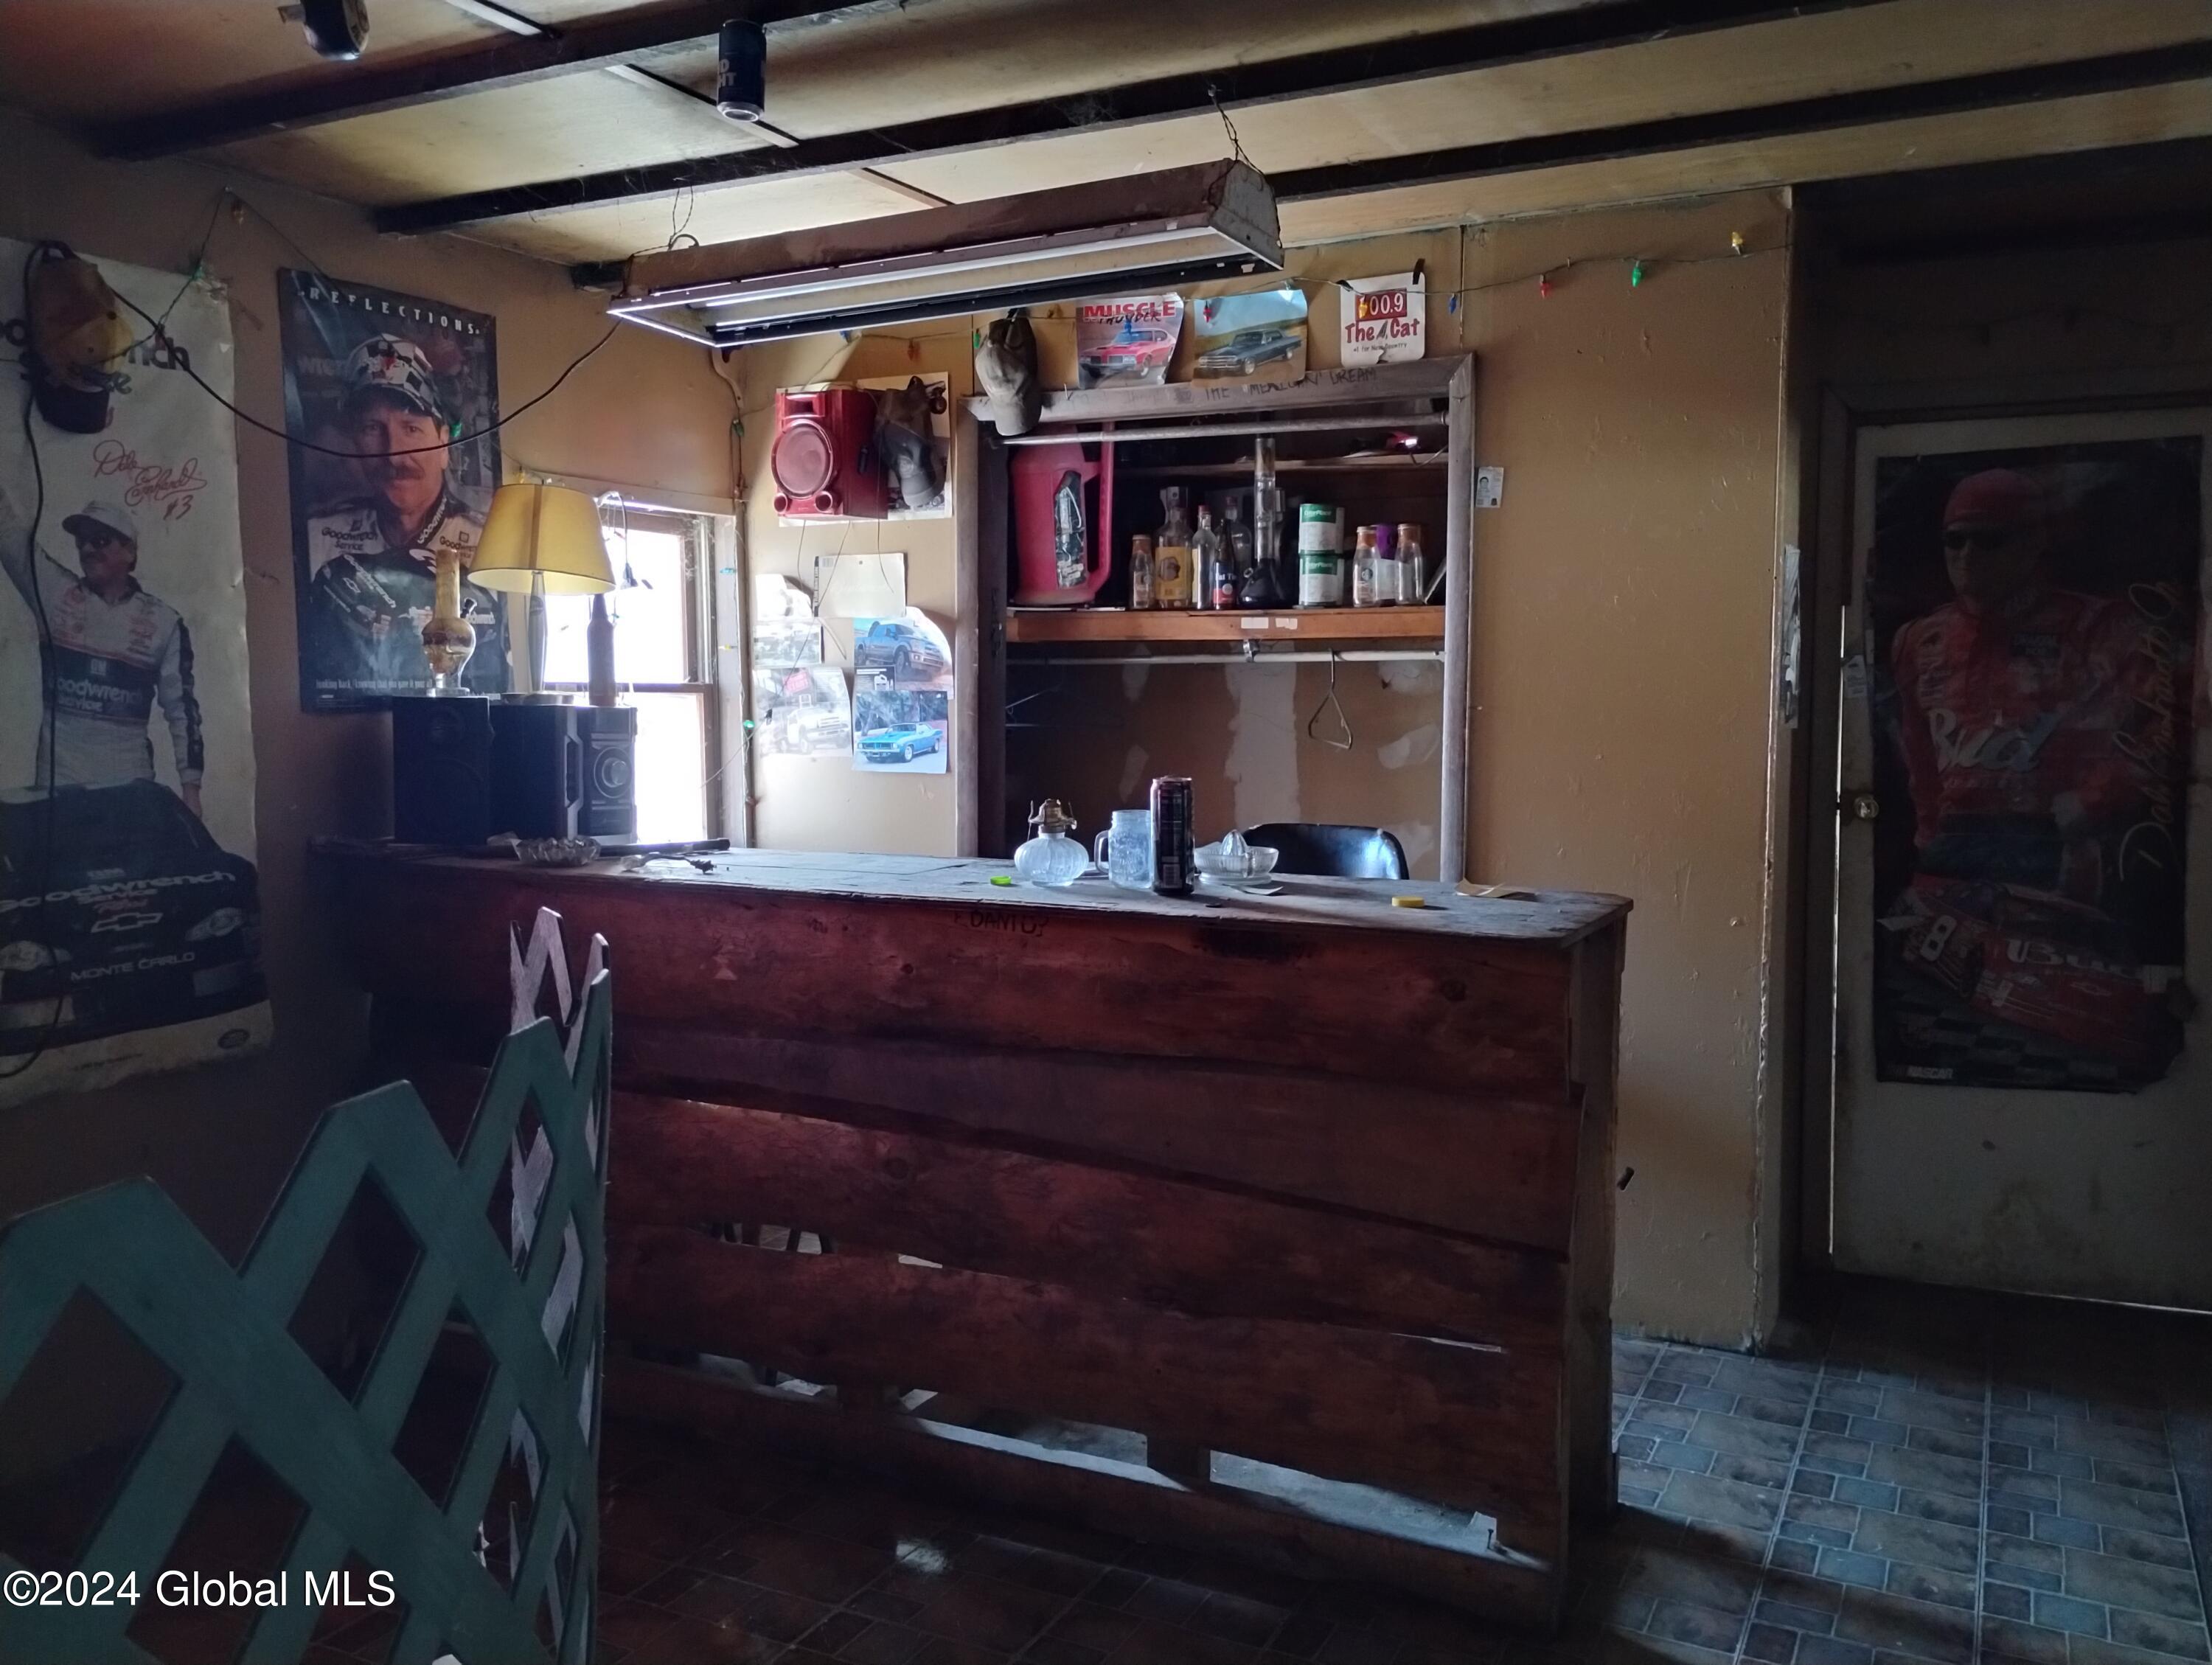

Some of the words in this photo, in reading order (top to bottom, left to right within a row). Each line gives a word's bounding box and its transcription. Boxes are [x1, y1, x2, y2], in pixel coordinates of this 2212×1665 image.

[310, 287, 474, 335] REFLECTIONS
[1084, 302, 1175, 318] MUSCLE
[1360, 293, 1404, 318] 00.9
[1345, 321, 1375, 344] The
[1390, 317, 1420, 338] Cat
[1206, 387, 1231, 401] THE
[1330, 366, 1377, 386] DREAM
[163, 494, 194, 521] #3
[1920, 915, 1958, 962] 8
[70, 962, 134, 981] MONTE
[138, 951, 195, 970] CARLO
[1907, 1065, 1955, 1080] NASCAR
